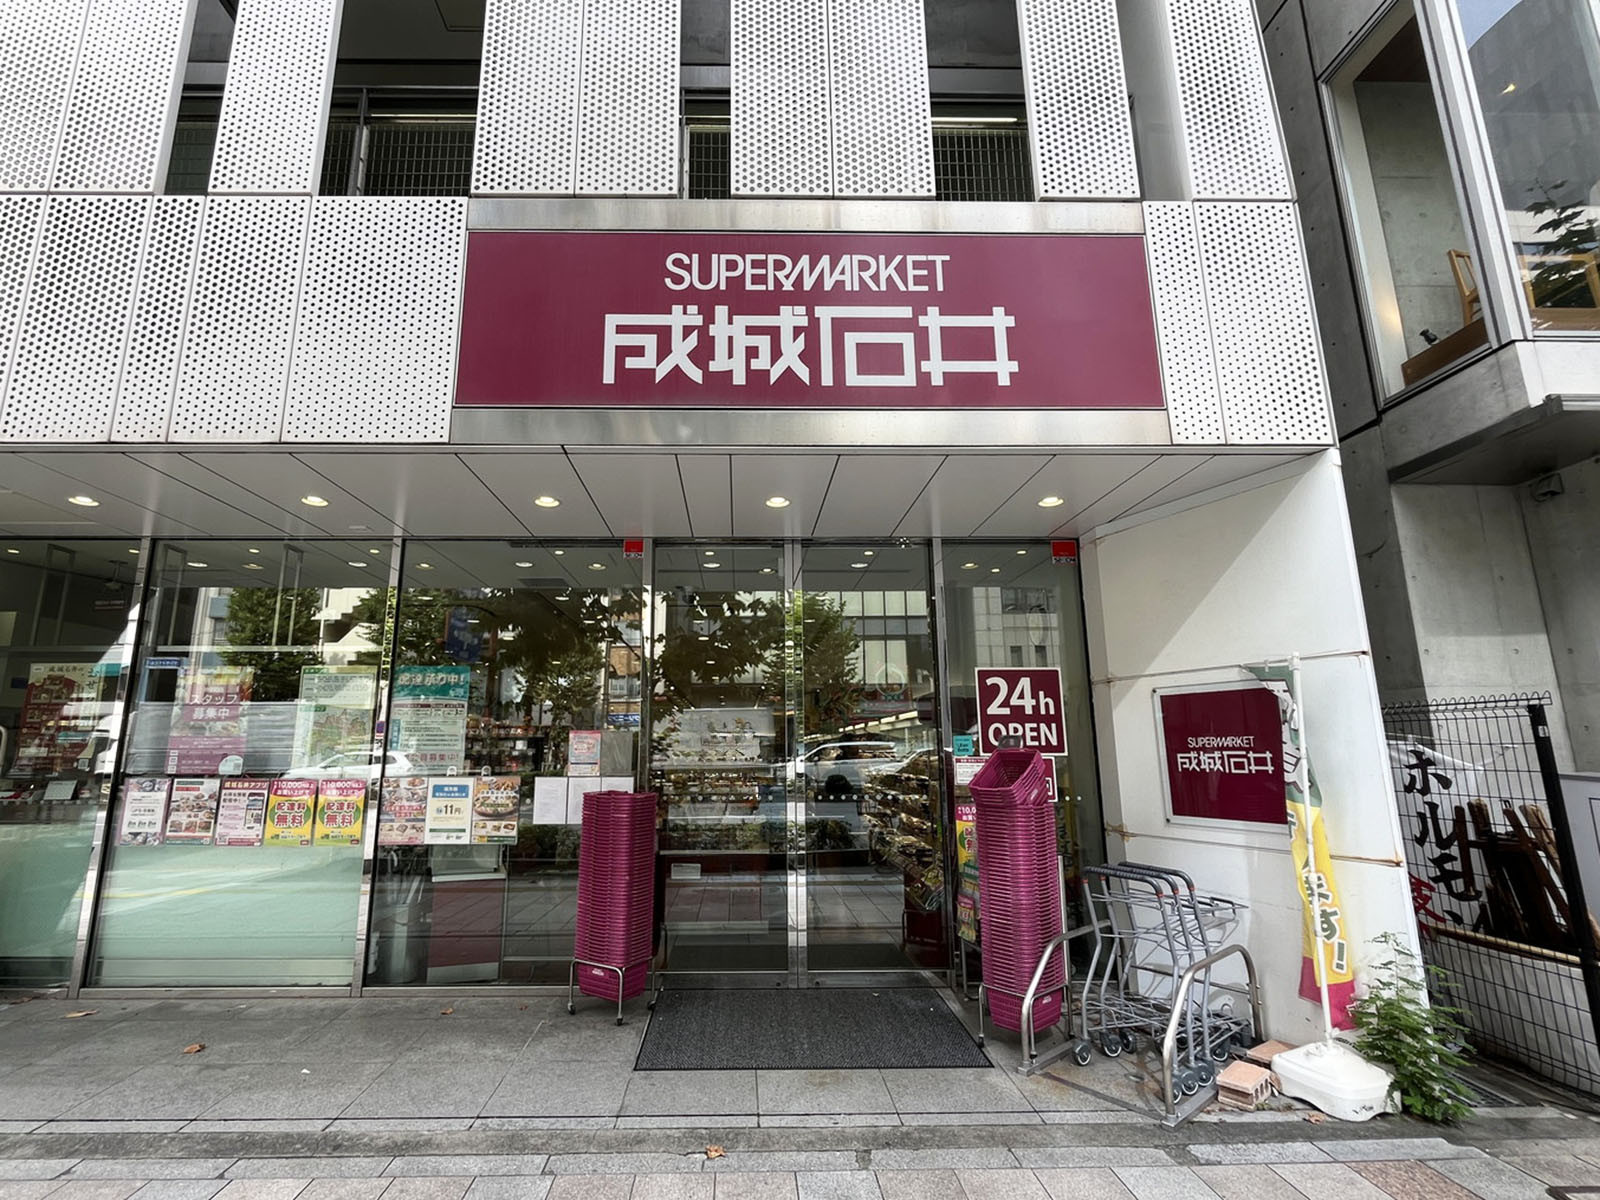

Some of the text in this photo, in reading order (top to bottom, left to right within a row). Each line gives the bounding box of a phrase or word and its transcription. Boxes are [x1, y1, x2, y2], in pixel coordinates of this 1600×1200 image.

[664, 252, 951, 292] SUPERMARKET
[602, 304, 1019, 387] 成城石井
[190, 694, 238, 705] スタッフ
[985, 676, 1055, 716] 24h
[192, 707, 230, 720] 募集中
[988, 722, 1058, 747] OPEN
[1187, 736, 1255, 748] SUPERMARKET
[1176, 750, 1275, 774] 成城石井
[274, 813, 305, 828] 無料
[324, 813, 355, 828] 無料
